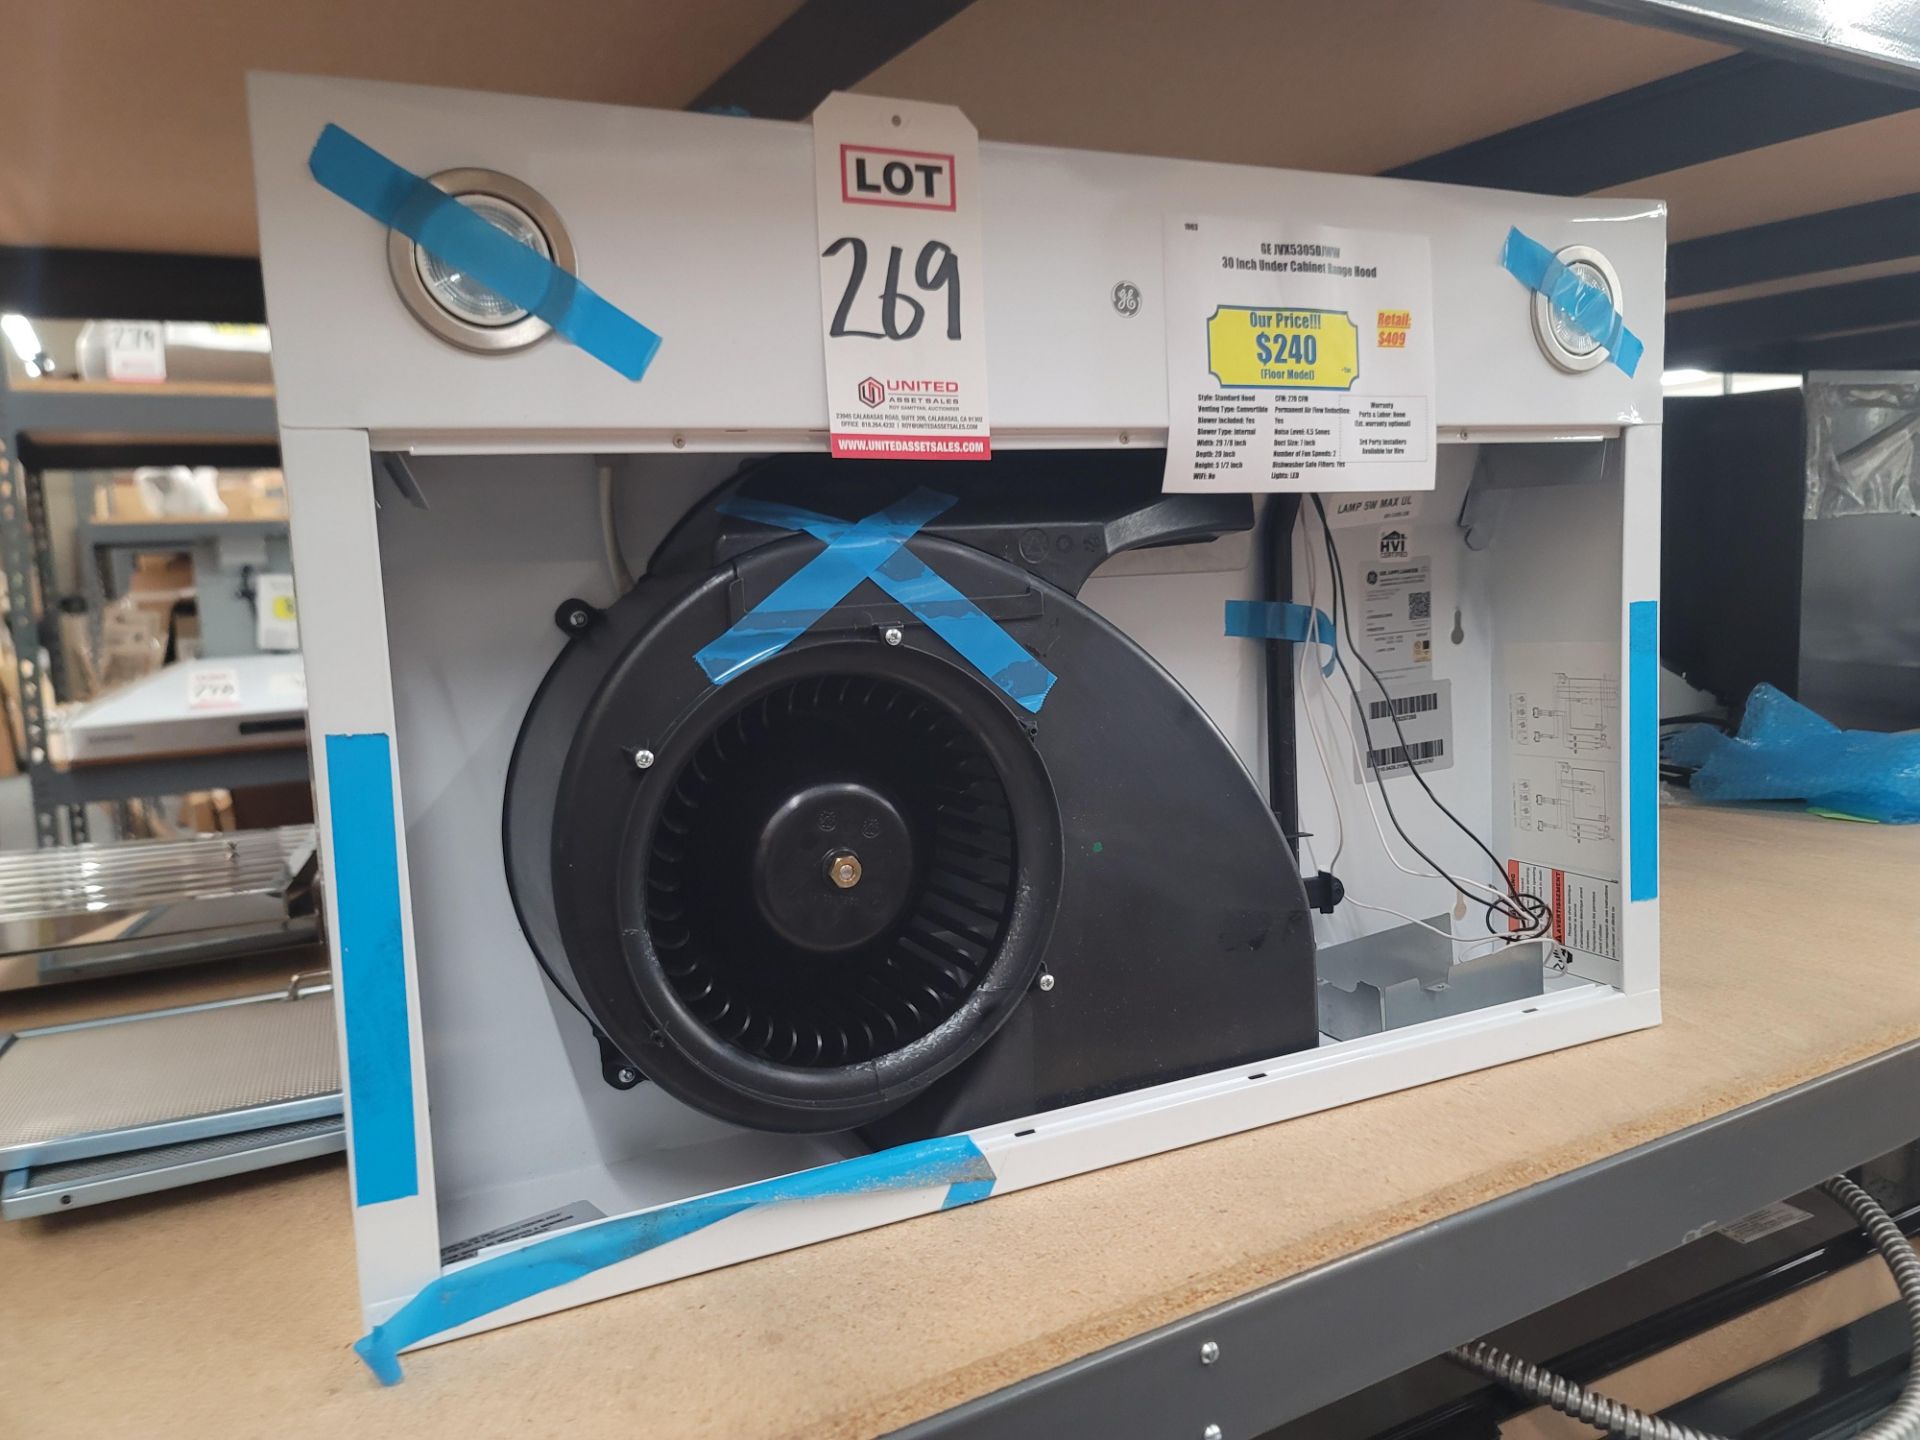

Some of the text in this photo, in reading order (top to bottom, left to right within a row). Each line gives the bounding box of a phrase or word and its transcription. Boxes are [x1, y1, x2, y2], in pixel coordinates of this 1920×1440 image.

[855, 158, 943, 198] LOT
[1260, 244, 1271, 254] GE
[1222, 257, 1377, 278] 30 Inch Under Cabinet Range Hood
[822, 237, 961, 341] 269
[1250, 312, 1321, 330] Our Price!!!
[1377, 312, 1411, 329] Retail:
[1378, 332, 1406, 348] $409
[1256, 332, 1316, 366] $240
[1260, 368, 1314, 380] (Floor Model)
[887, 380, 959, 393] UNITED
[1198, 394, 1213, 403] Style:
[1215, 394, 1240, 402] Standard
[1370, 402, 1394, 410] Warranty
[1198, 406, 1218, 414] Venting
[1197, 428, 1216, 436] Blower
[838, 439, 984, 453] WWW.UNITEDASSETSALES.COM
[1337, 502, 1362, 514] LAMP
[1380, 497, 1400, 508] MAX
